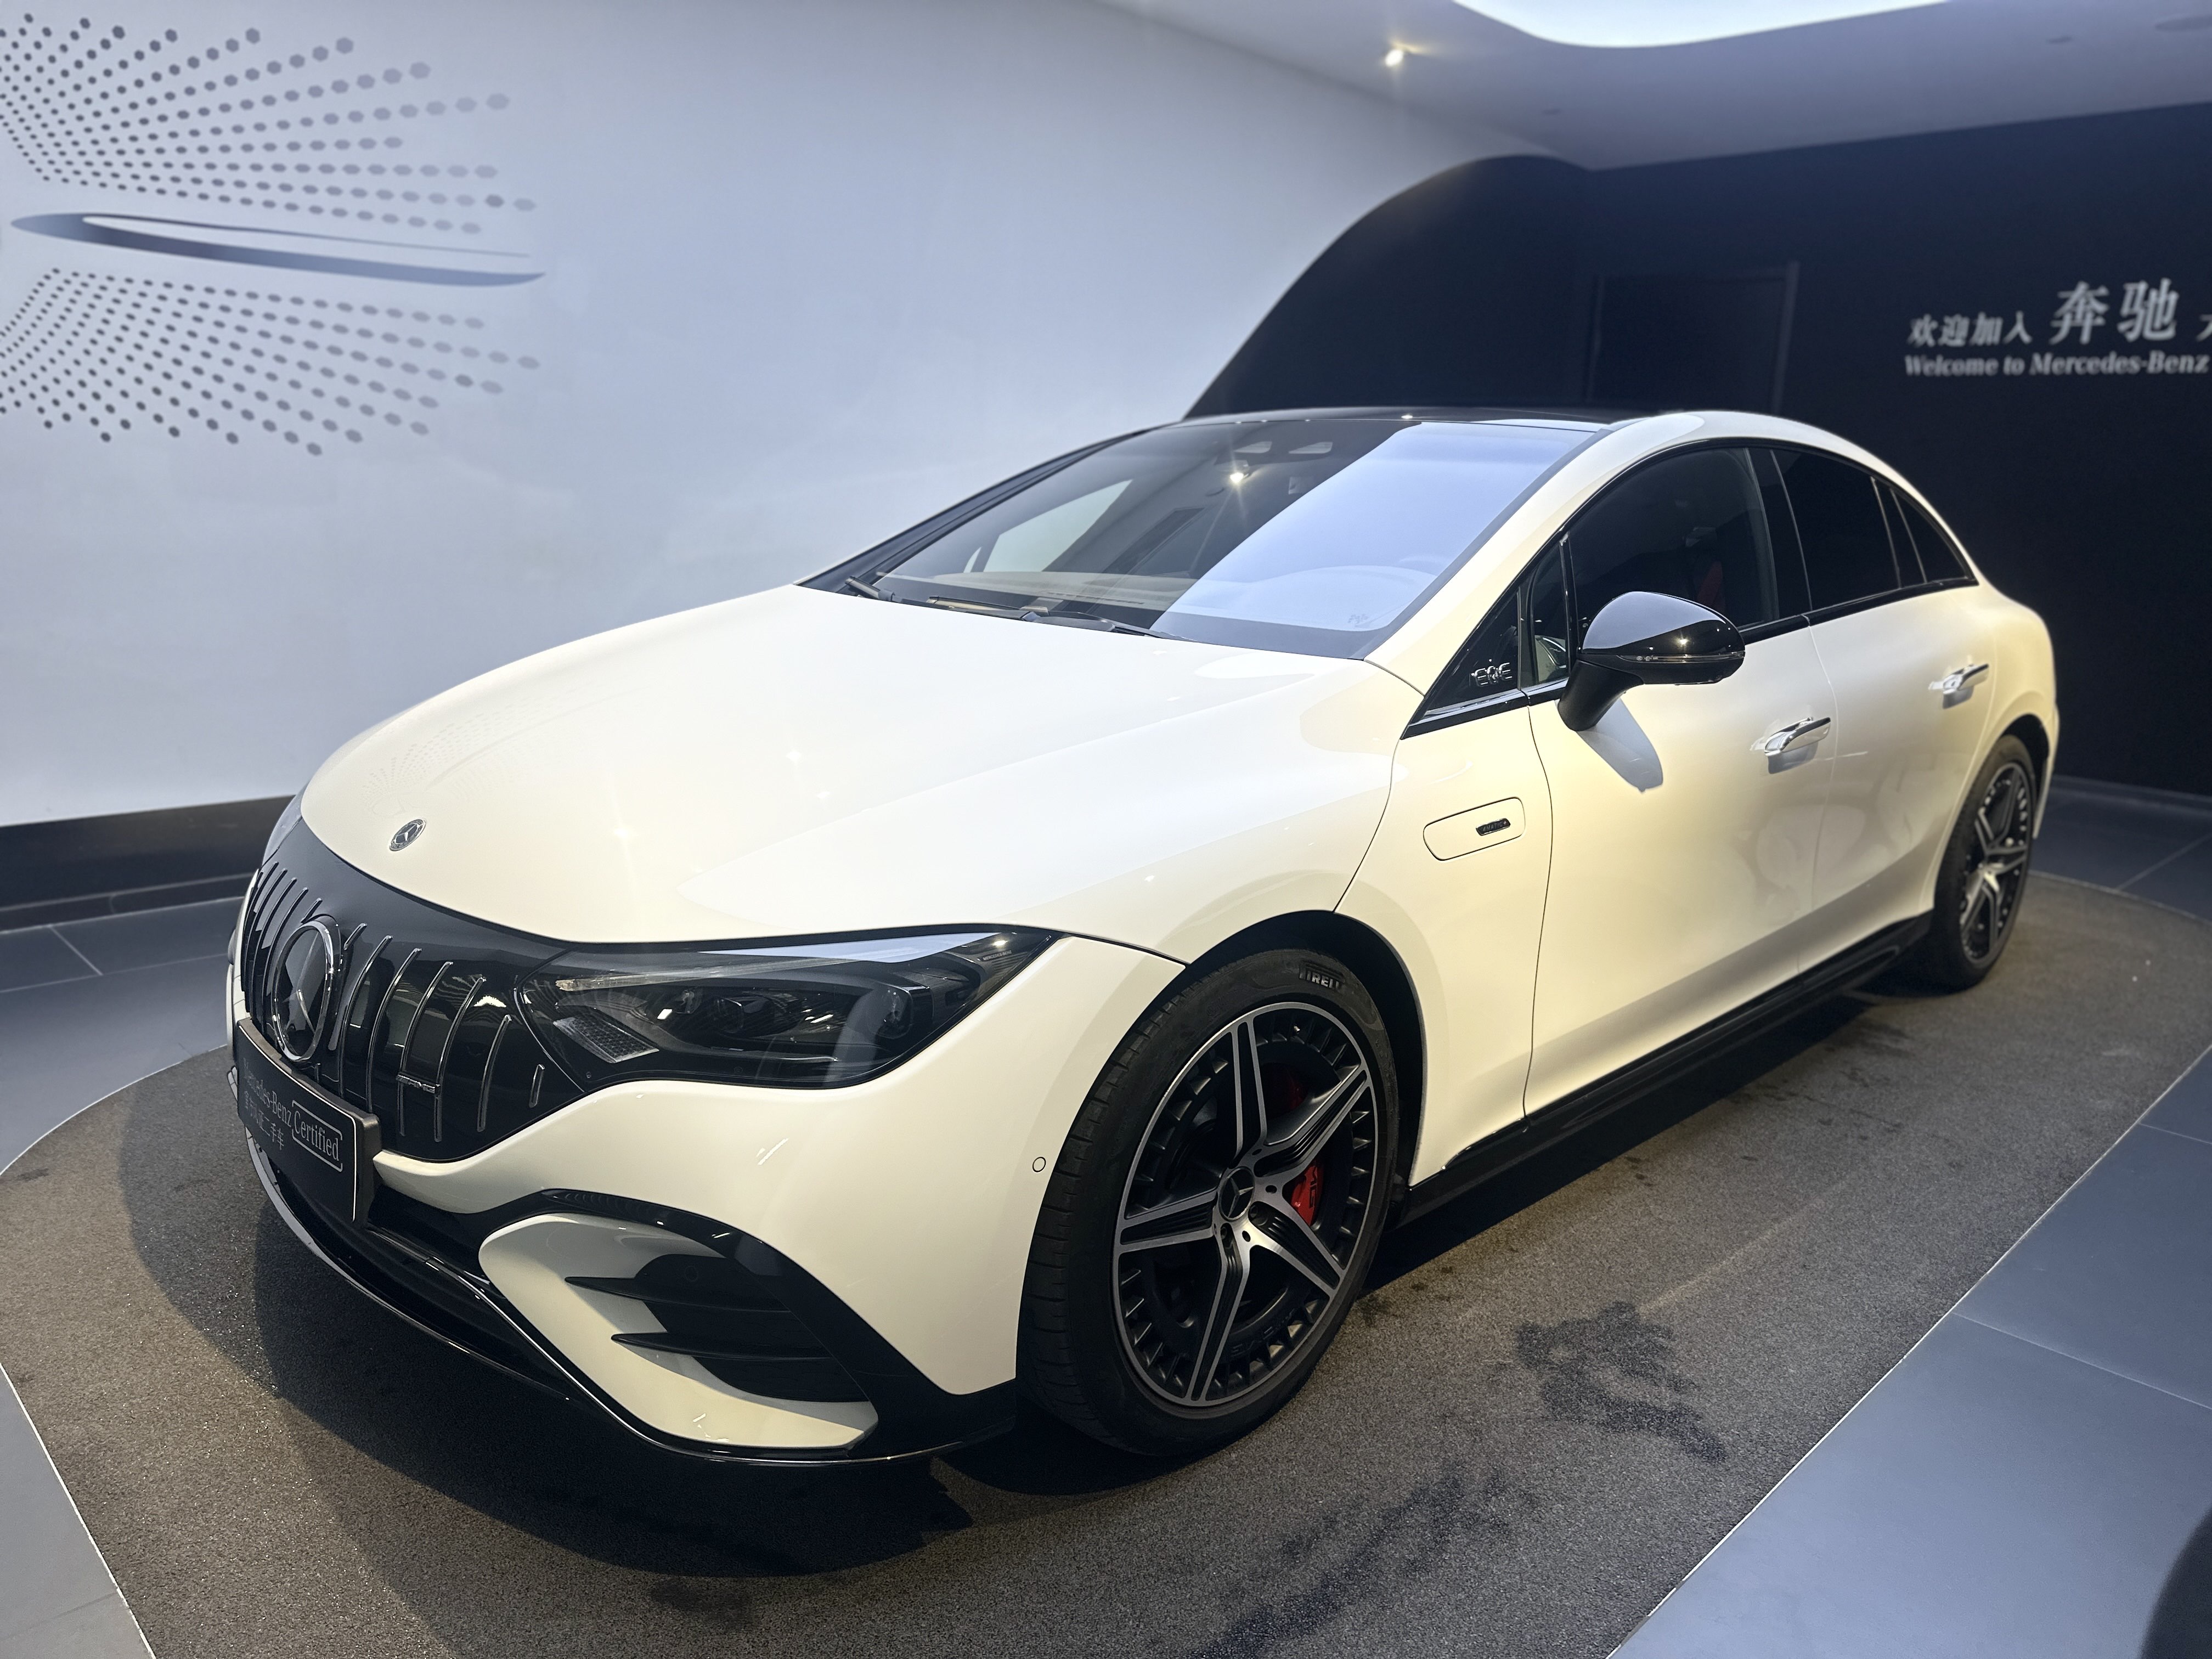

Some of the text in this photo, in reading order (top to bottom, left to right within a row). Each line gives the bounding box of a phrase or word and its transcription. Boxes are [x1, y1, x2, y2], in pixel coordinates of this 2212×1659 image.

[1908, 309, 2032, 347] 欢迎加入
[2049, 278, 2179, 345] 奔驰
[1904, 349, 2210, 376] Welcome to Mercedes-Benz
[1472, 662, 1513, 686] EQE
[294, 1110, 340, 1161] Certified
